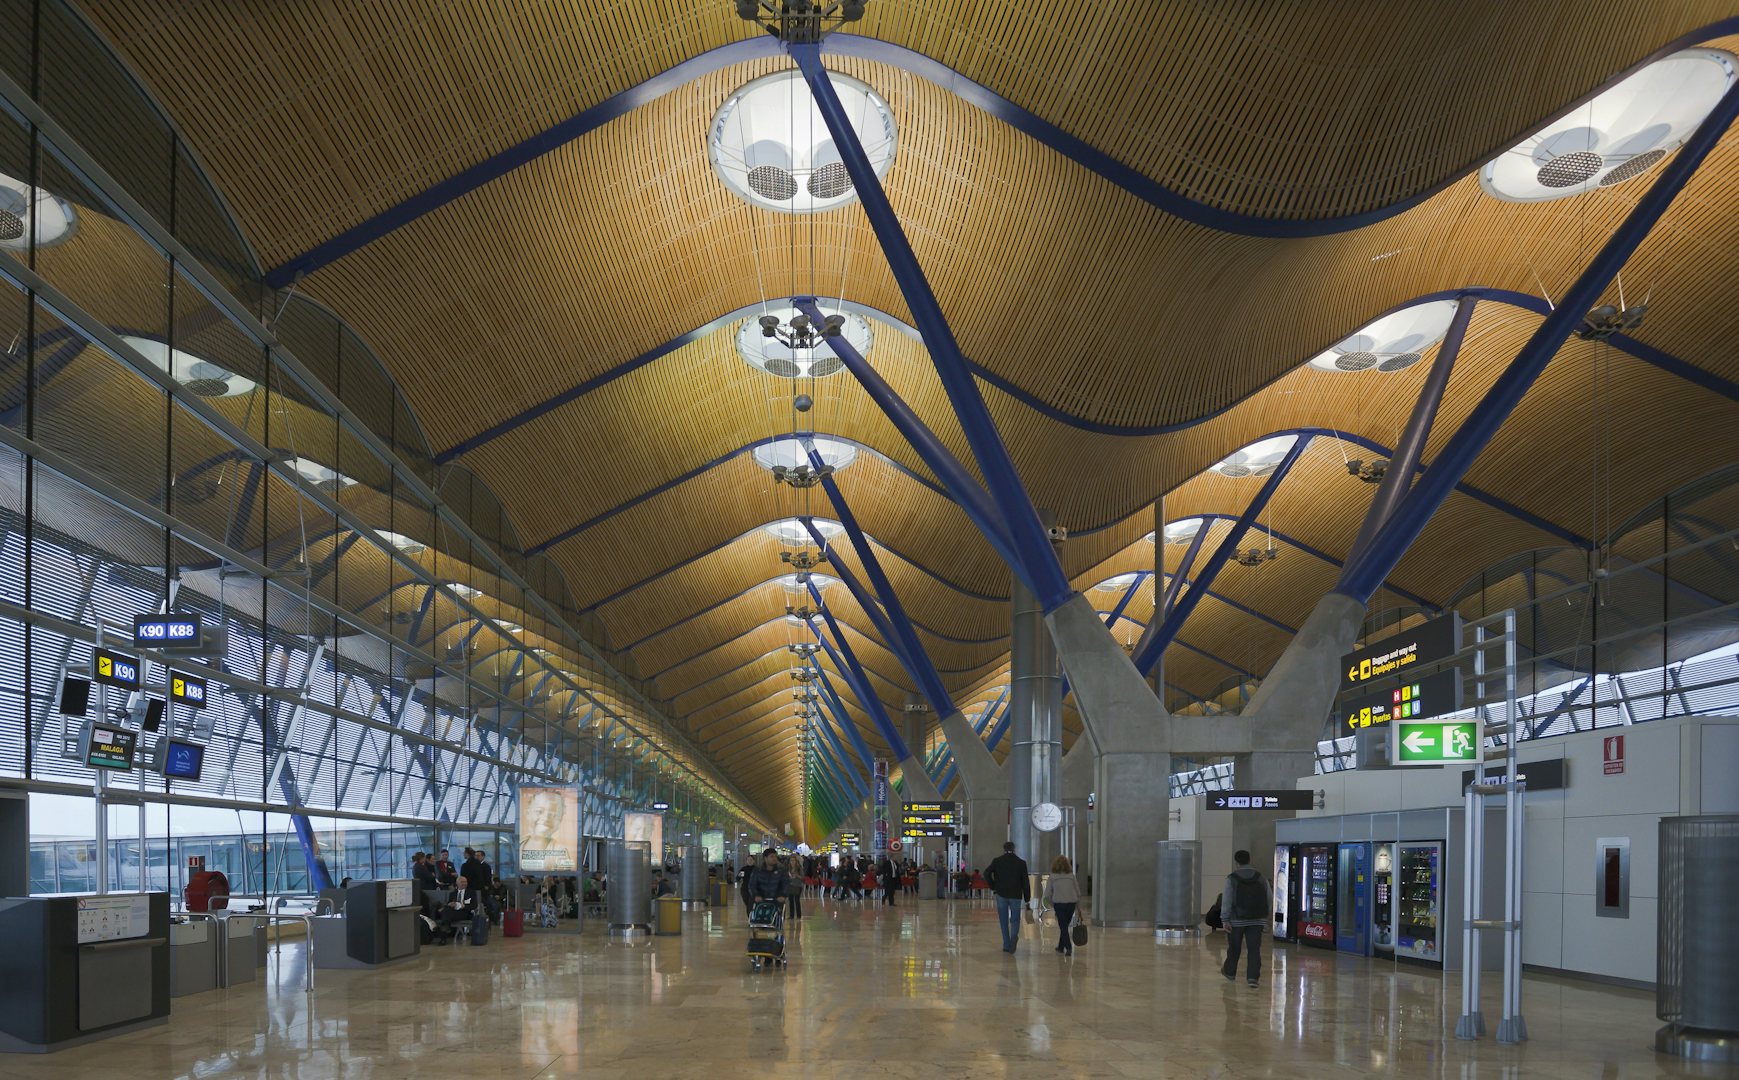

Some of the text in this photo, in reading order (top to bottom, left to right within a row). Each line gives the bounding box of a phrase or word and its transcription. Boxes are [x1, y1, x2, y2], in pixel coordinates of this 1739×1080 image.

[139, 625, 194, 637] K90 K88
[1372, 642, 1417, 665] Baggage and way out
[1372, 653, 1417, 675] Equipajes y salida
[115, 664, 135, 680] K90
[186, 684, 203, 699] K88
[1394, 691, 1400, 701] H
[1412, 685, 1420, 696] M
[1372, 705, 1384, 714] Gates
[1394, 702, 1419, 718] R S U
[1373, 714, 1391, 724] Puertas
[100, 744, 124, 753] MALAGA
